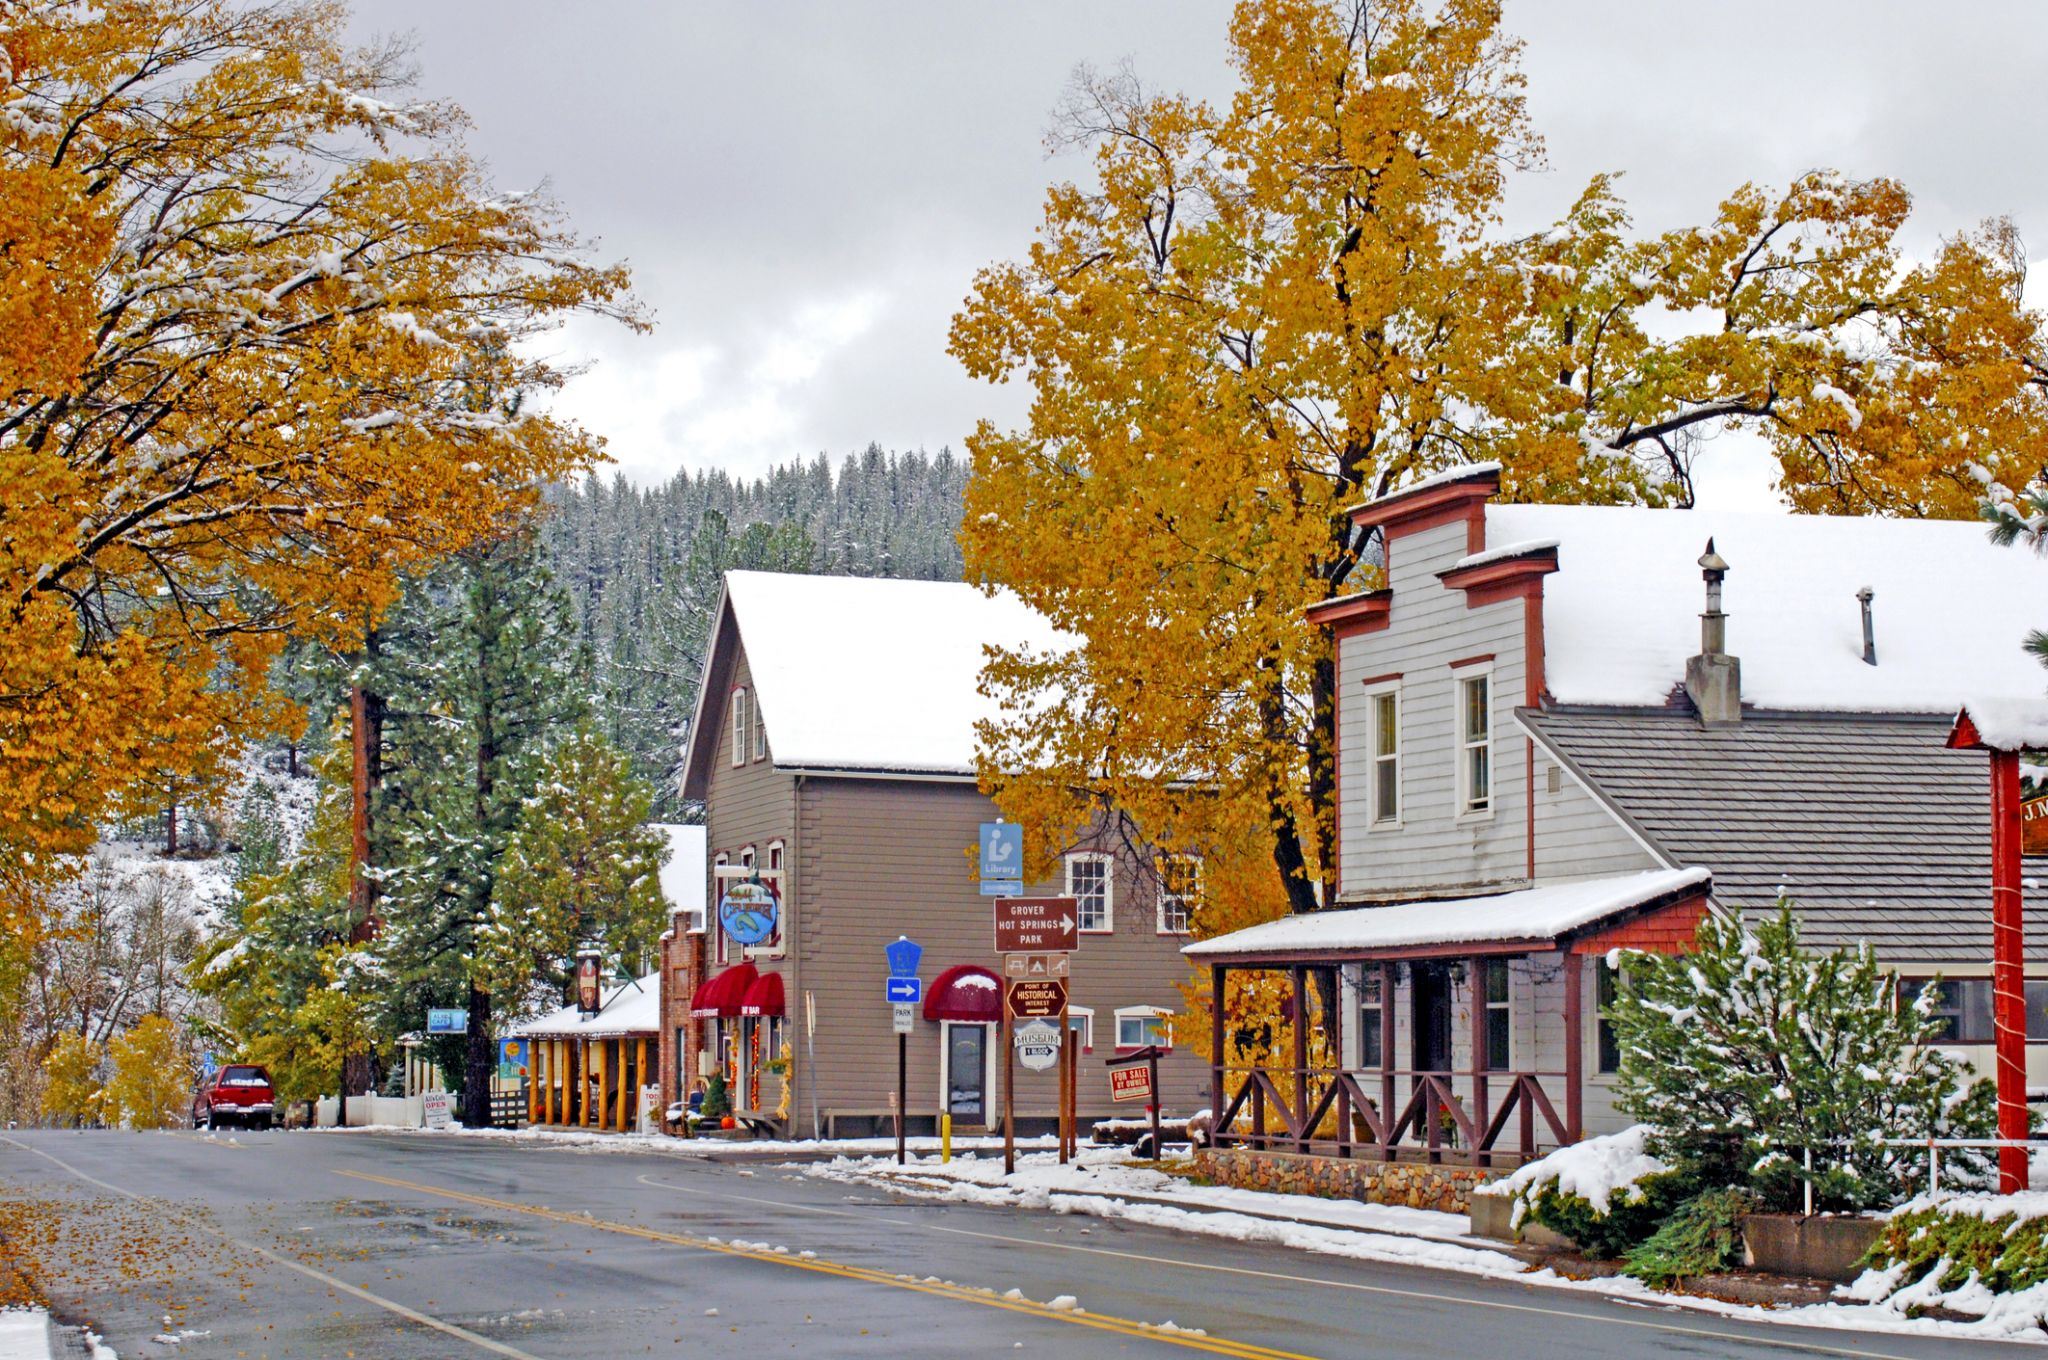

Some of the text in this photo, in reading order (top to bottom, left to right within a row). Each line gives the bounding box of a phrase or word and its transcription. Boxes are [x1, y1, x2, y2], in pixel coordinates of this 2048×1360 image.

[985, 863, 1016, 875] Library
[1010, 905, 1045, 915] GROVER
[999, 919, 1058, 930] HOT SPRINGS
[1020, 934, 1042, 944] PARK
[1017, 990, 1058, 1000] HISTORICAL
[748, 1006, 760, 1015] BAR
[895, 1009, 911, 1017] PARK
[1017, 1033, 1058, 1045] MUSEUM
[1113, 1068, 1147, 1082] FOR SALE
[1117, 1078, 1147, 1089] BY OWNER
[425, 1101, 446, 1109] OPEN
